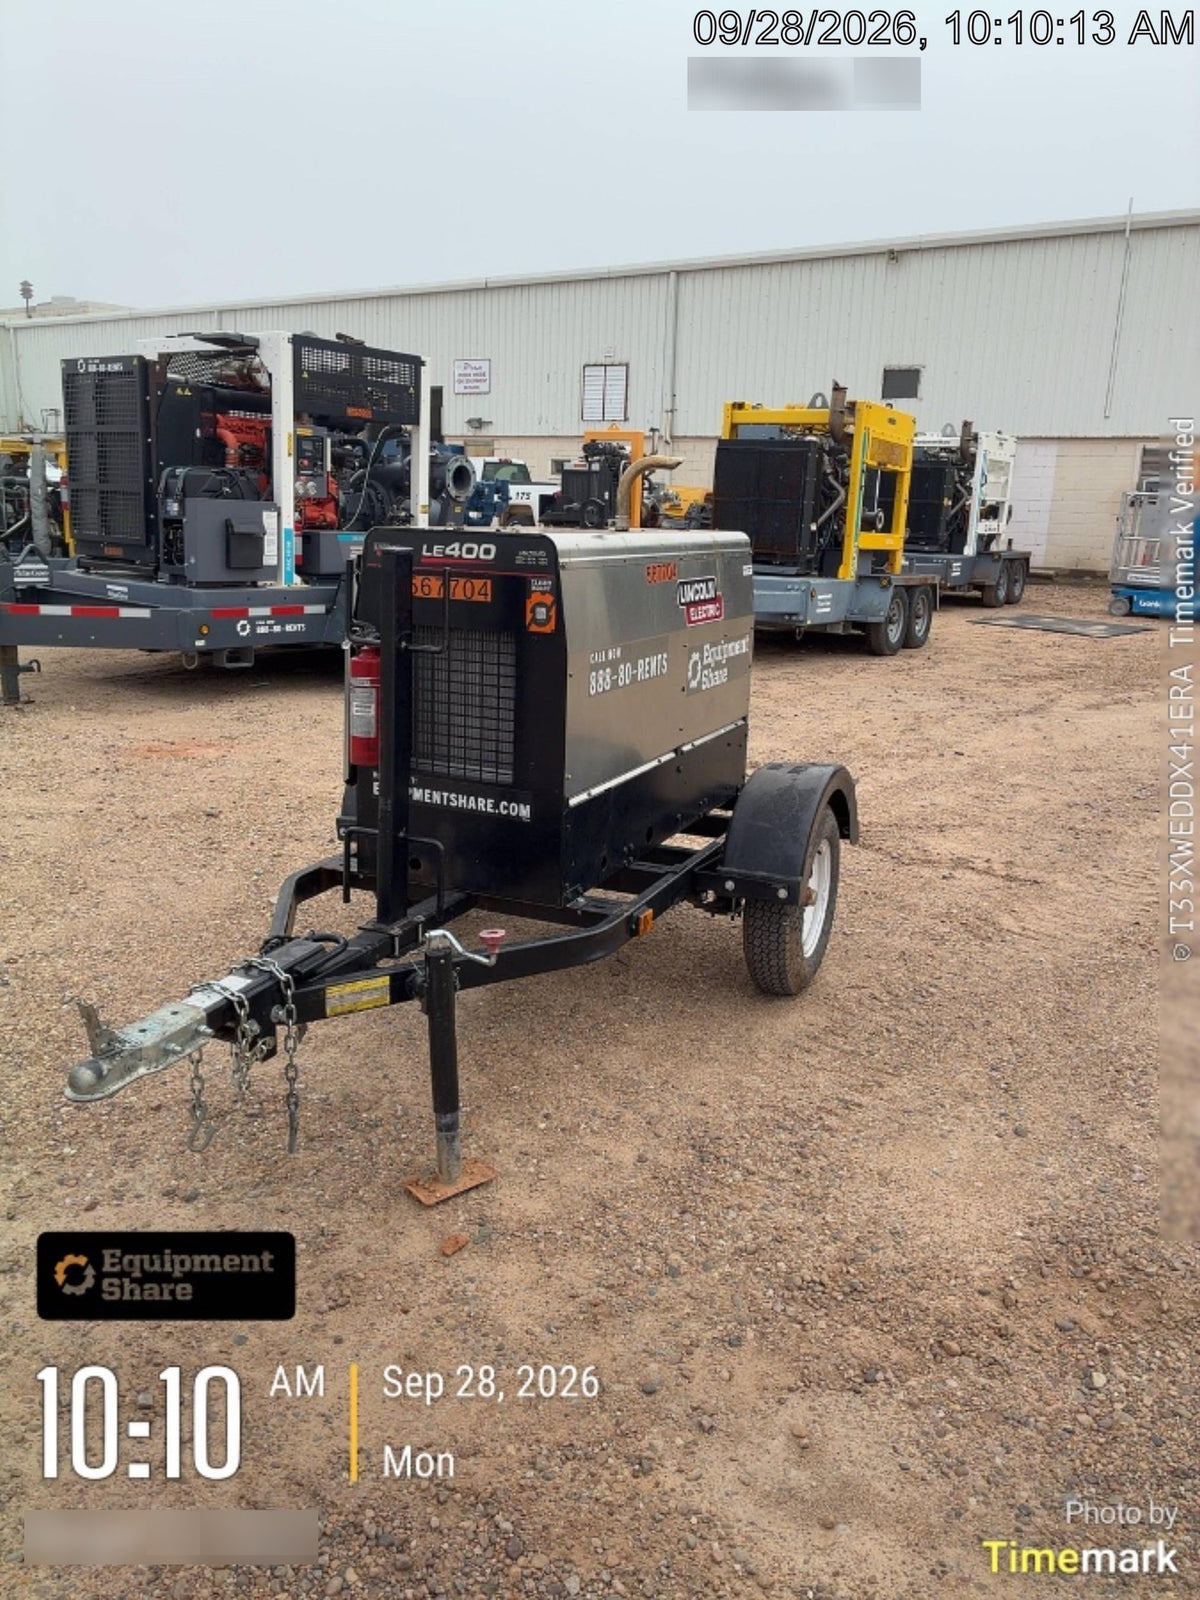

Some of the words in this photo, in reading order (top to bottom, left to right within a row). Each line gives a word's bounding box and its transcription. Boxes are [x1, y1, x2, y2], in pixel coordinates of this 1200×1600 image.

[422, 541, 497, 560] LE400
[680, 581, 716, 603] LINCOLN
[589, 652, 668, 696] 888-80-RENTS
